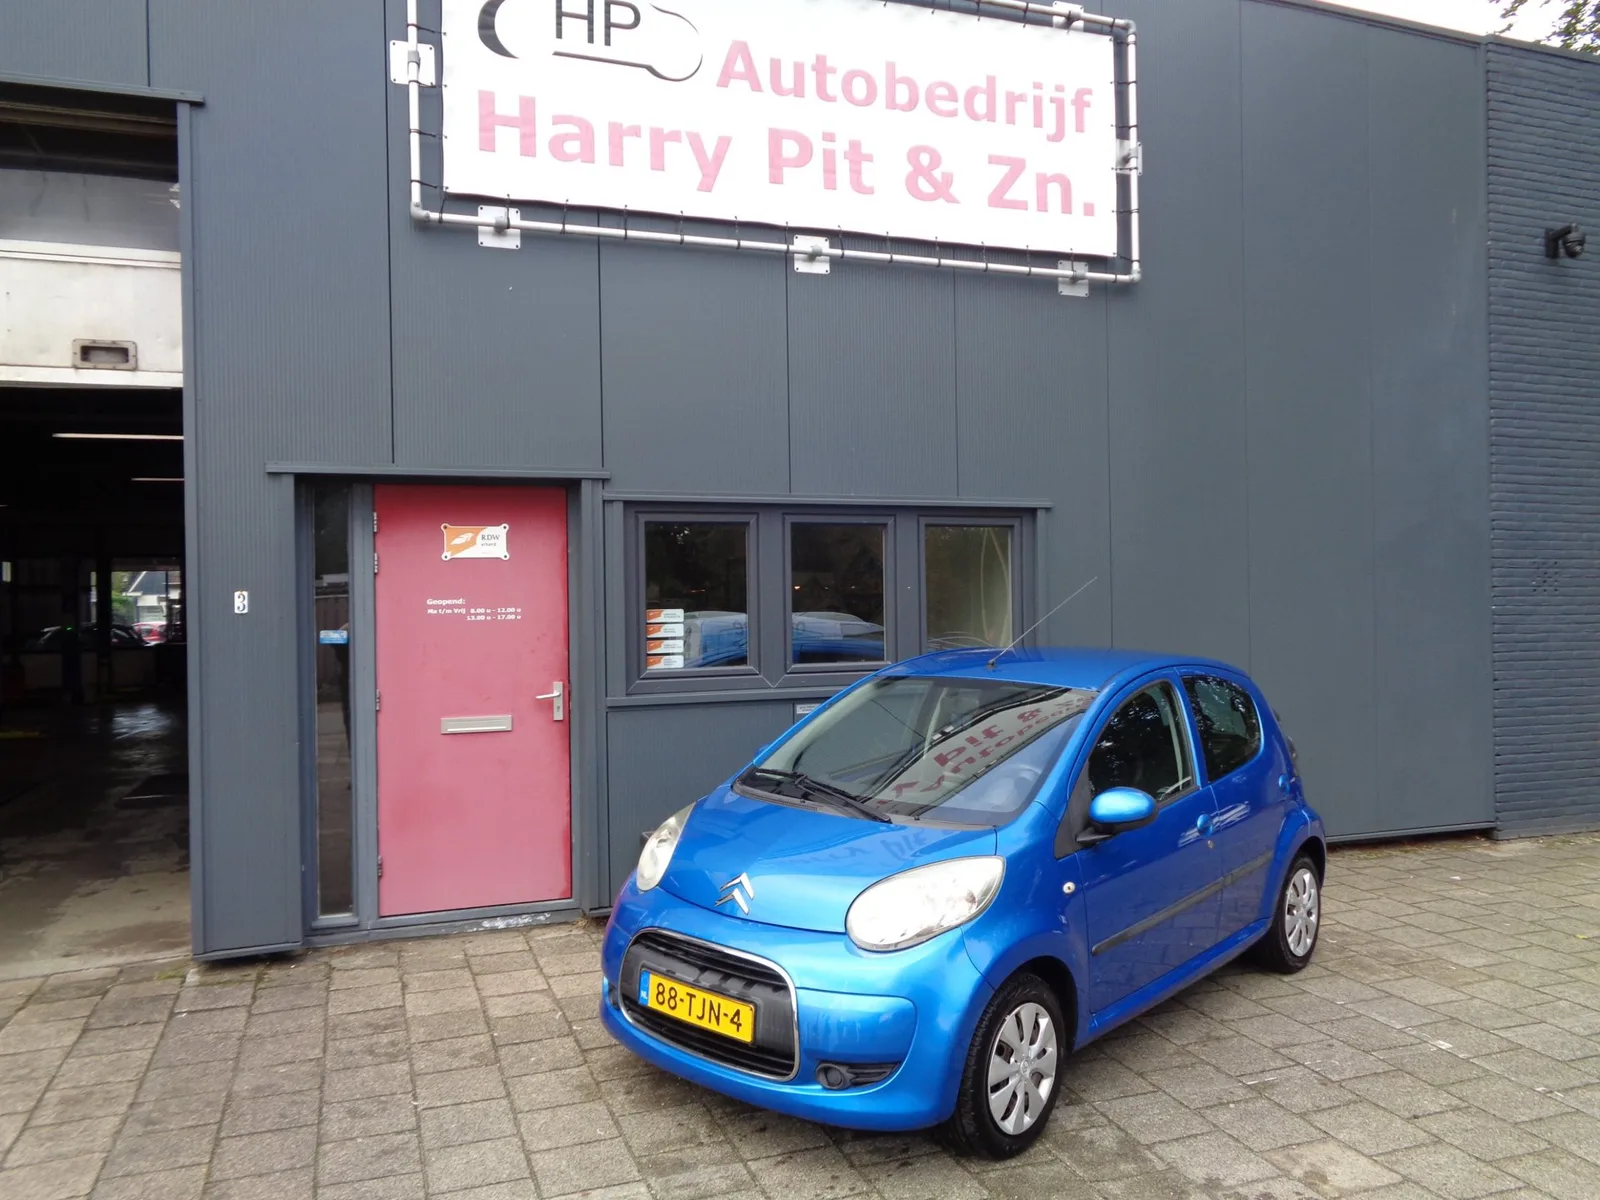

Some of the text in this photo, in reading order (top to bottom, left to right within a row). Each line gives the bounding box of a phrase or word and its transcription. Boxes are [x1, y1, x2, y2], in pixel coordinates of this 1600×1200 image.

[716, 40, 1093, 142] Autobedrijf
[477, 90, 1096, 216] Harry Pit & Zn.
[237, 593, 246, 612] 3
[426, 598, 466, 606] Geopend:
[640, 990, 648, 1000] NL
[656, 982, 742, 1032] 88-TJN-4
